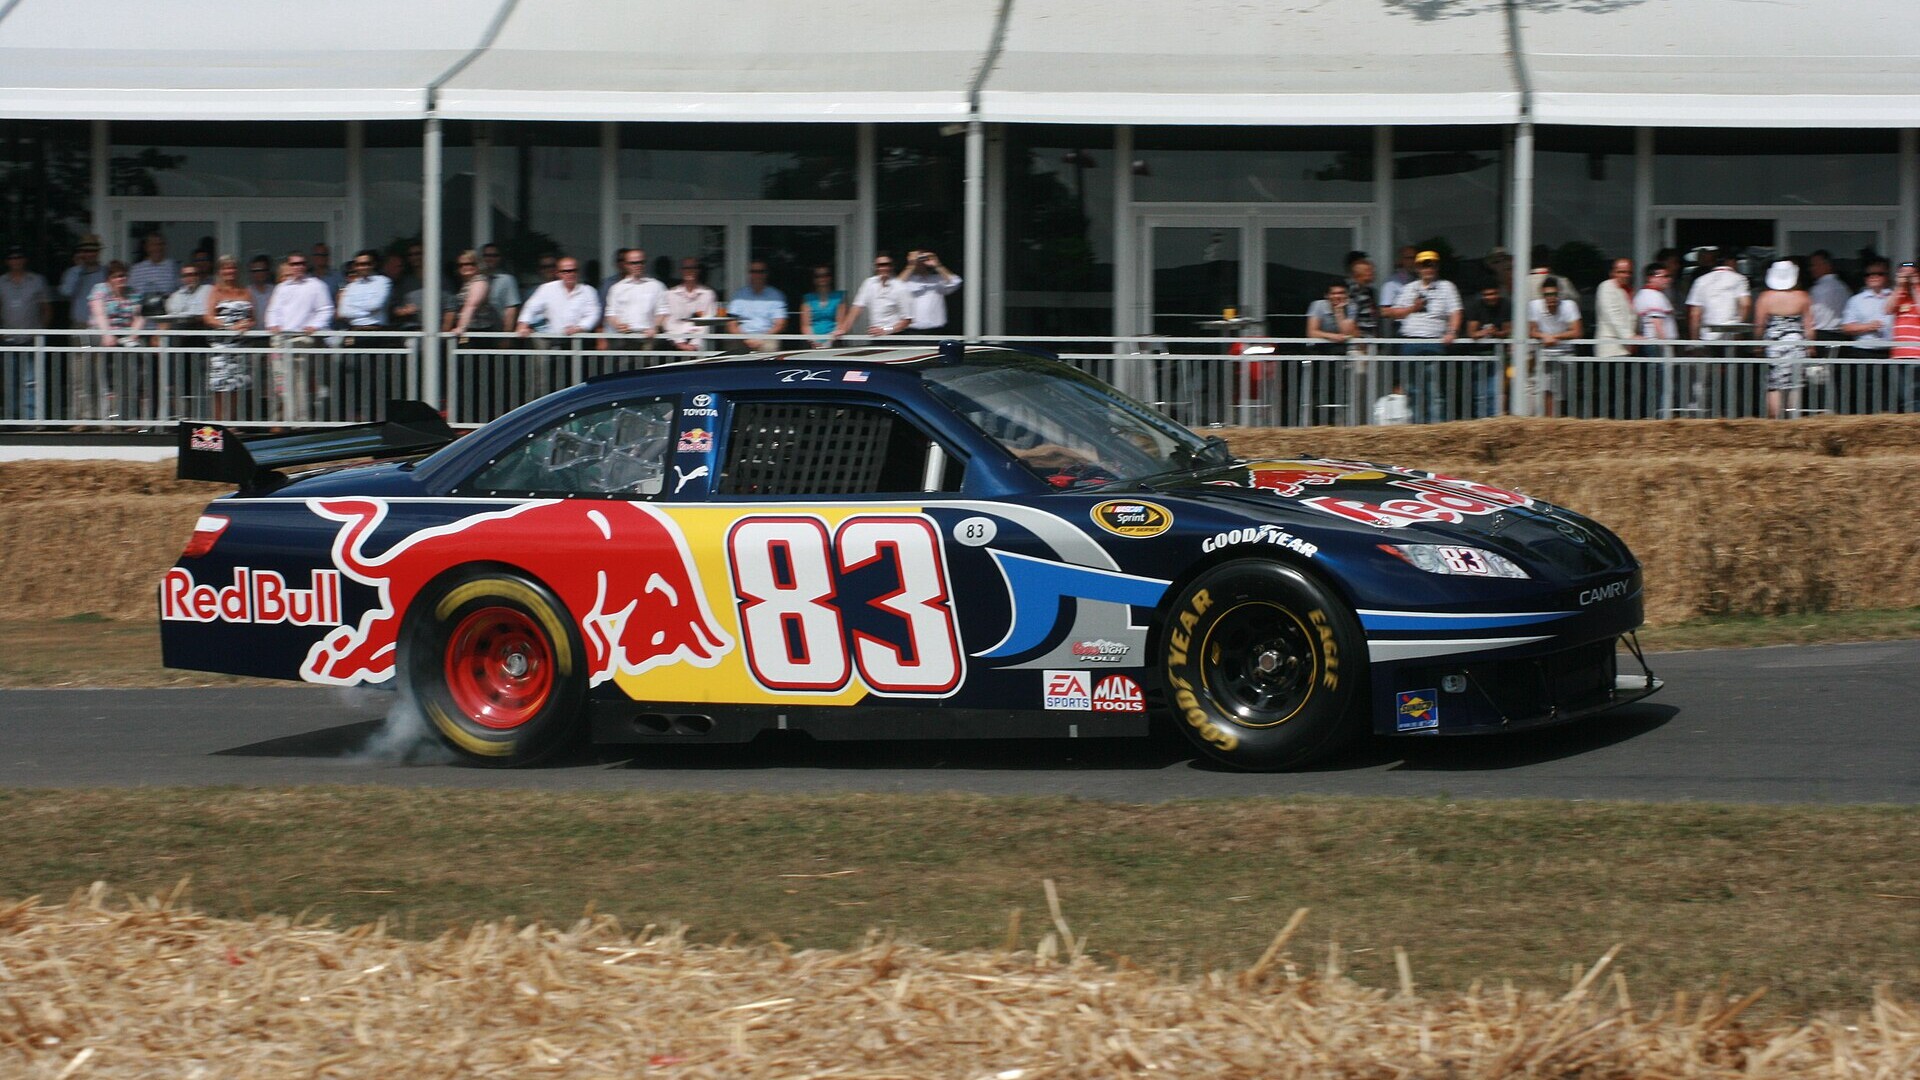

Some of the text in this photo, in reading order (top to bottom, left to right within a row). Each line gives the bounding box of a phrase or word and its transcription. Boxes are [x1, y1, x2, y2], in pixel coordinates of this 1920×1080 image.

[682, 408, 719, 417] TOYOTA
[1117, 513, 1146, 525] Sprint
[966, 523, 984, 539] 83
[1438, 547, 1489, 574] 83
[161, 567, 343, 627] Red Bull
[1579, 579, 1629, 606] CAMRY
[724, 512, 968, 699] 83
[1099, 645, 1131, 656] LIGHT
[1307, 608, 1340, 692] EAGLE
[1047, 674, 1087, 697] EA
[1093, 676, 1143, 701] MAC
[1046, 697, 1090, 709] SPORTS
[1093, 701, 1144, 711] TOOLS
